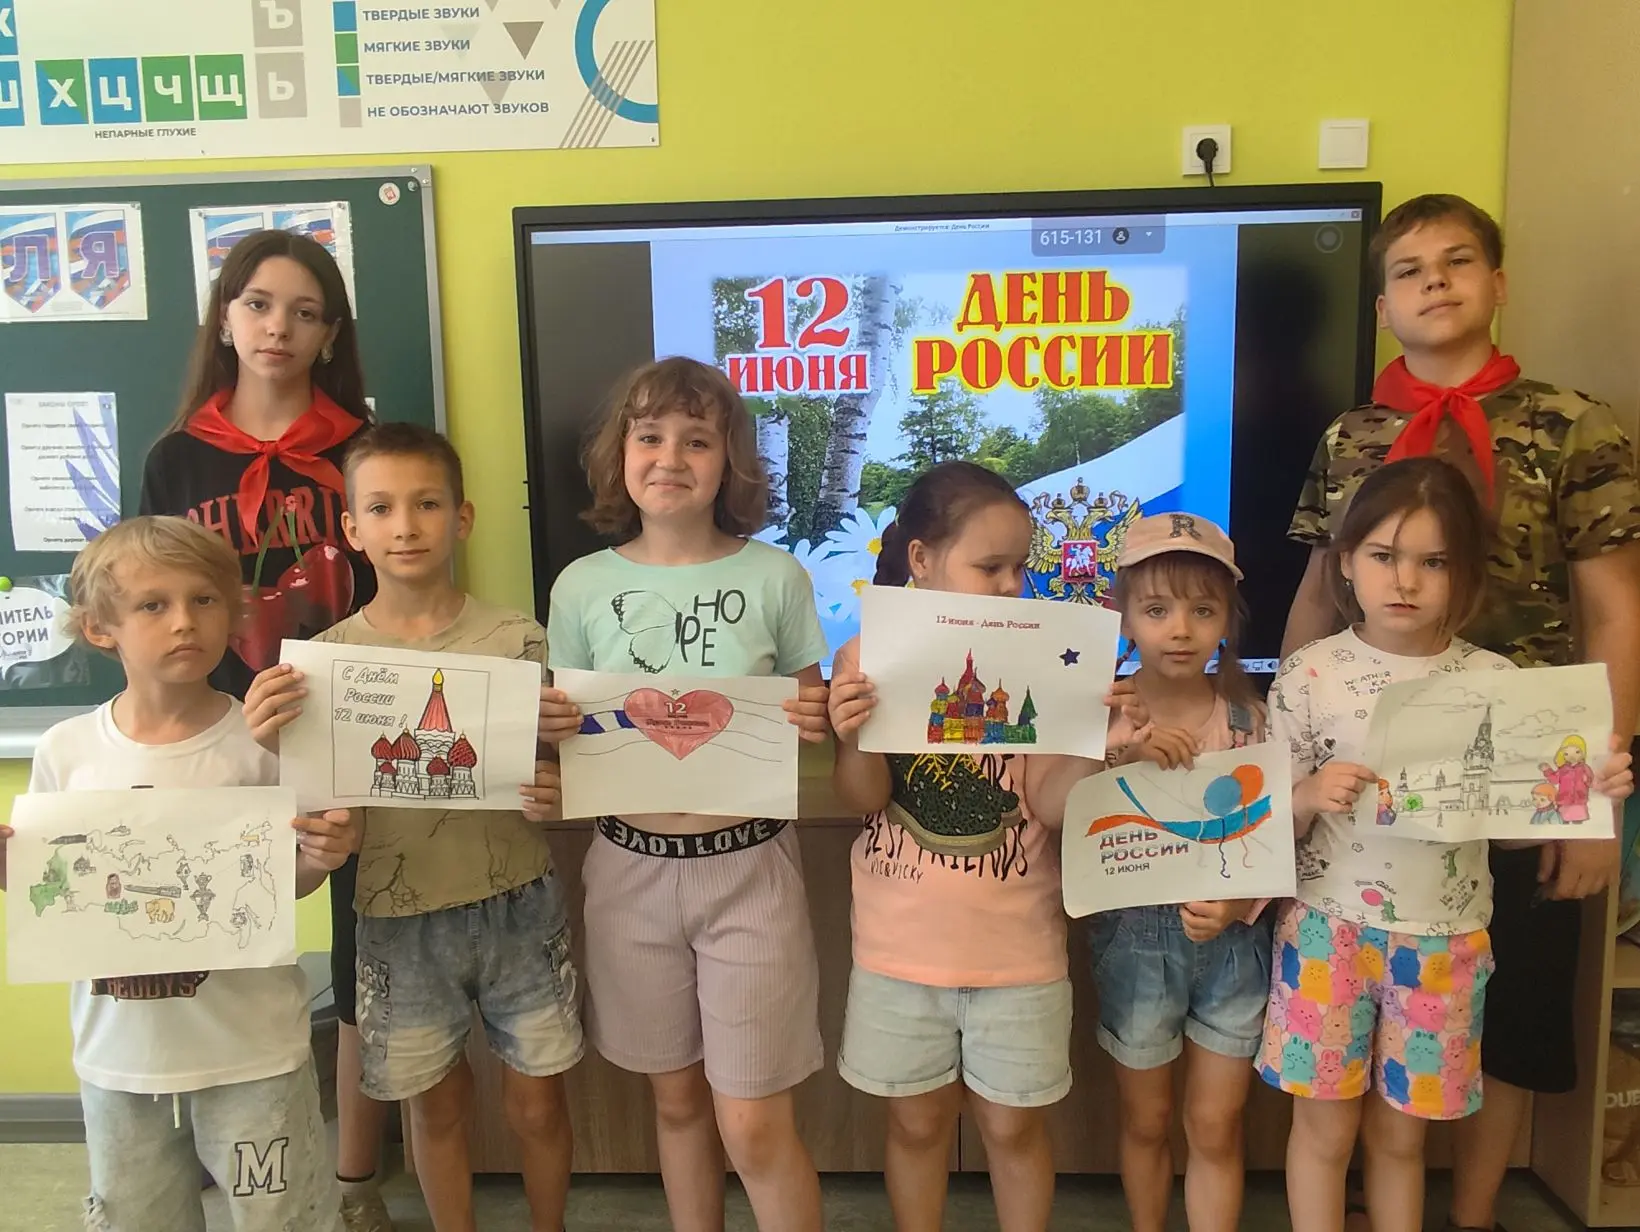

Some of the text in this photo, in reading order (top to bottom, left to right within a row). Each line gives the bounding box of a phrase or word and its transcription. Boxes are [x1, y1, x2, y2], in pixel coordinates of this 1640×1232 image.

[363, 7, 480, 22] ТВЕРДЫЕ ЗВУКИ
[363, 39, 471, 54] МЯГКИЕ ЗВУКИ
[365, 69, 545, 86] ТВЕРДЫЕ/МЯГКИЕ ЗВУКИ
[367, 102, 549, 118] НЕ ОБОЗНАЧАЮТ ЗВУКОВ
[94, 127, 197, 140] НЕПАРНЫЕ ГЛУХИЕ
[1040, 229, 1102, 246] 615-131
[9, 231, 120, 283] Л Я
[956, 270, 1131, 333] ДЕНЬ
[746, 276, 851, 349] 12
[914, 333, 1173, 391] РОССИИ
[726, 353, 870, 393] ИЮНЯ
[1169, 513, 1202, 539] R
[936, 615, 948, 624] 12
[980, 619, 1004, 629] День
[1006, 620, 1041, 630] России
[0, 627, 49, 646] ОРИИ
[354, 666, 400, 685] Днём
[343, 687, 396, 706] России
[334, 707, 353, 722] 12
[664, 701, 687, 714] 12
[695, 818, 772, 855] LOVE
[1099, 828, 1159, 850] ДЕНЬ
[1101, 841, 1189, 864] РОССИИ
[1104, 862, 1151, 876] 12 ИЮНЯ
[233, 1136, 290, 1198] M
